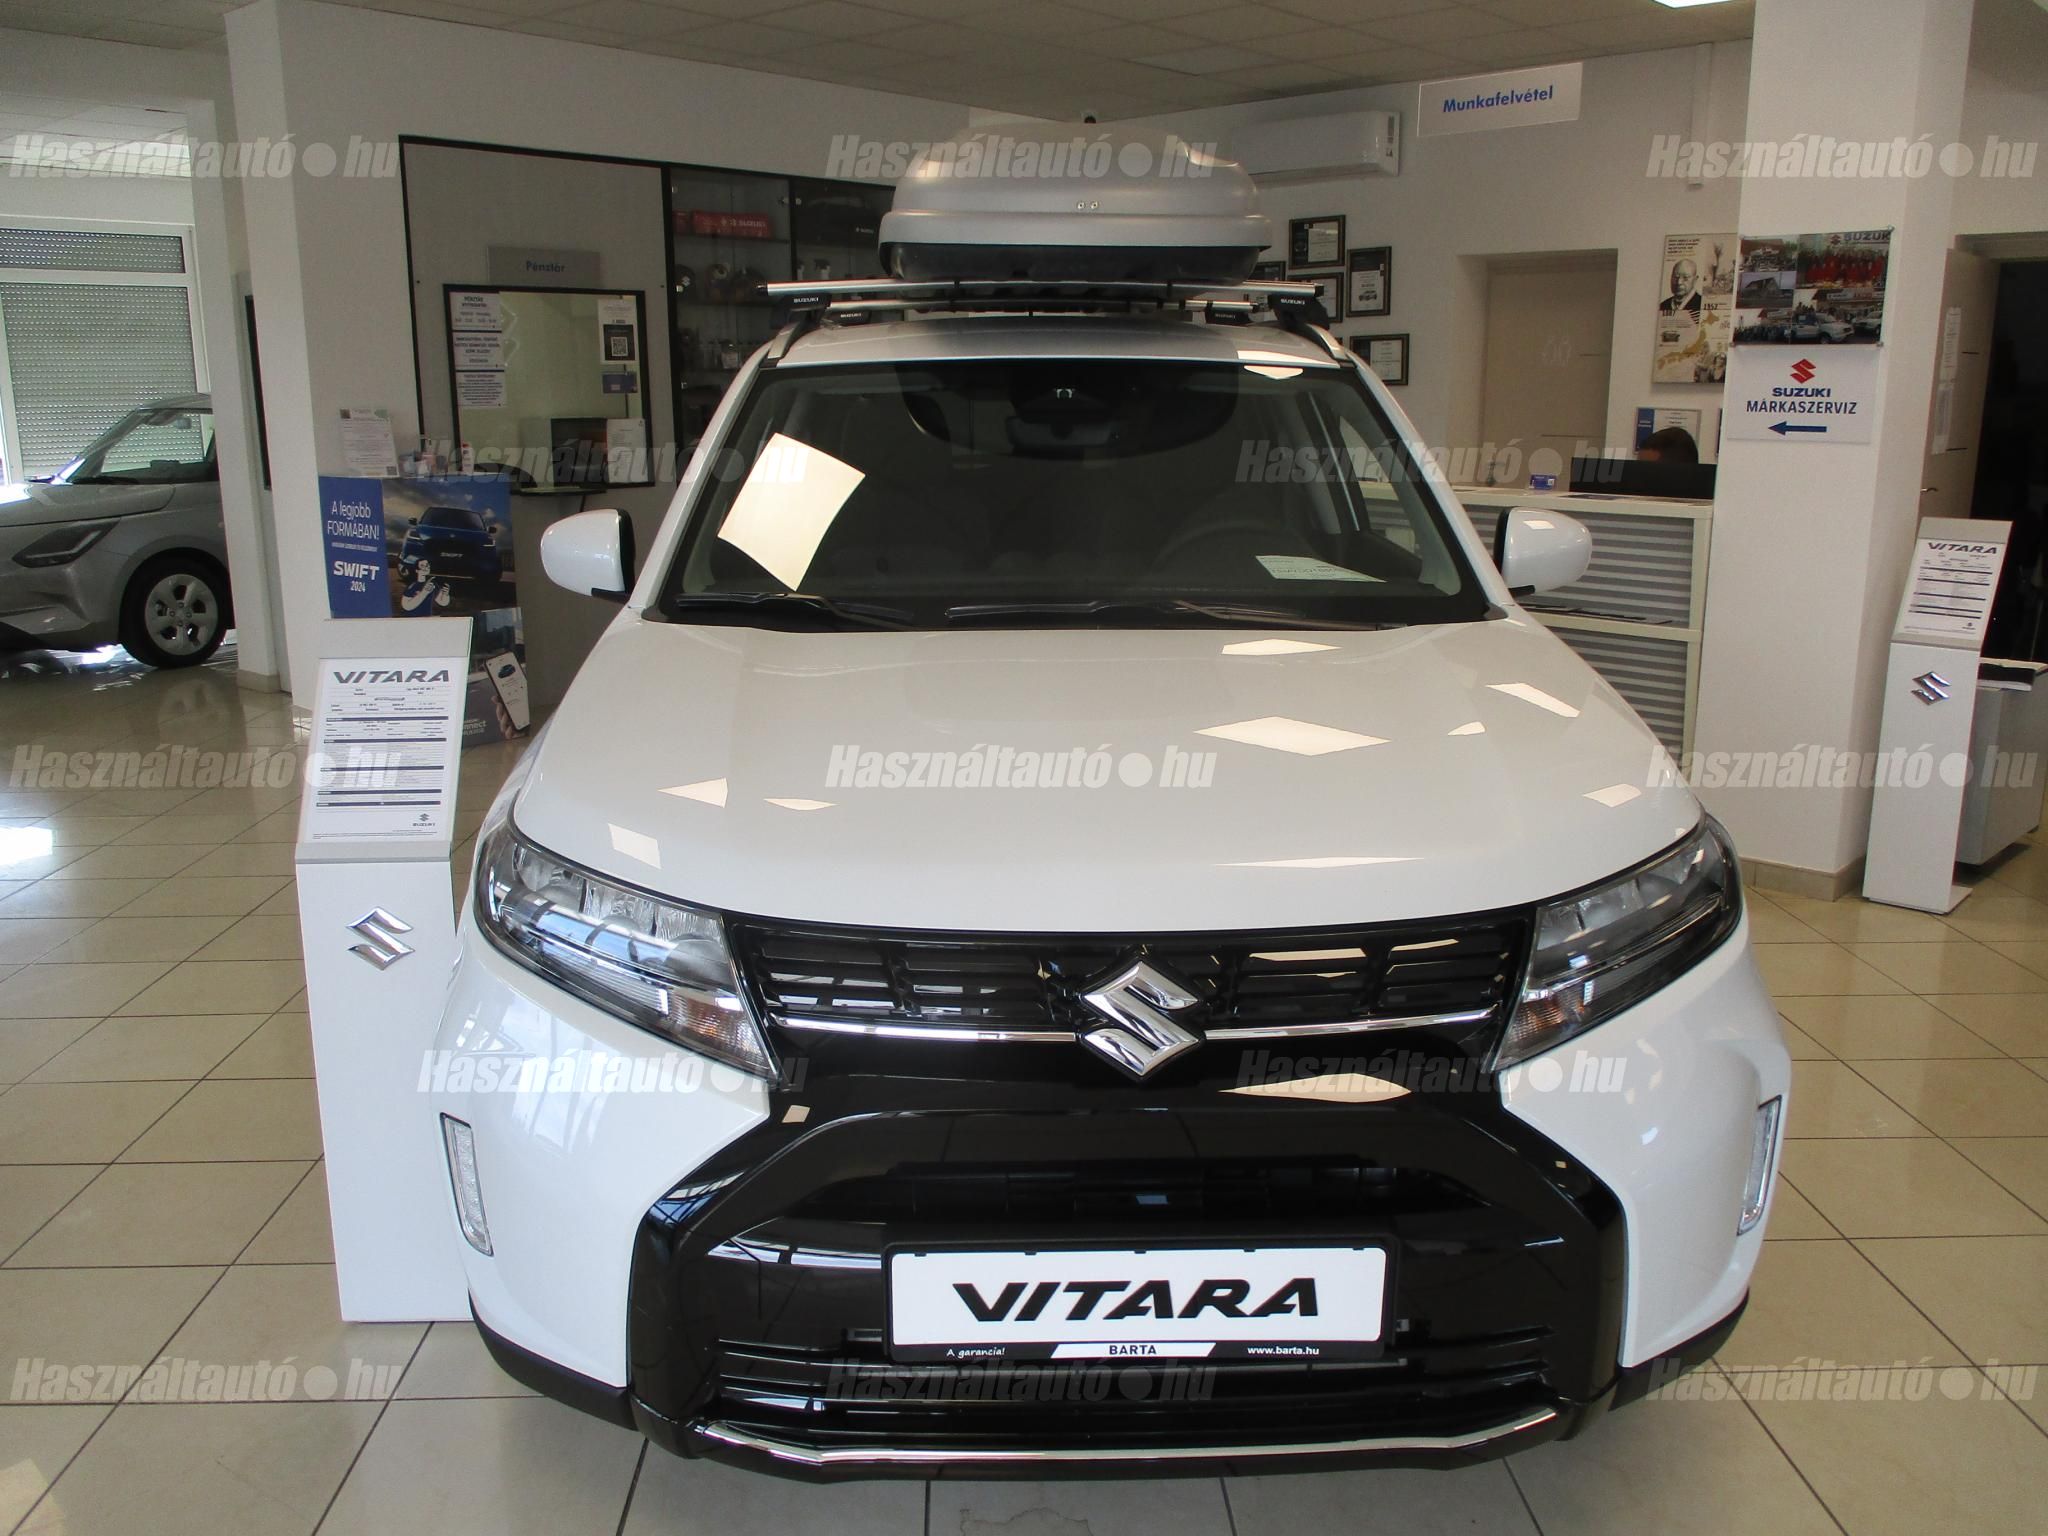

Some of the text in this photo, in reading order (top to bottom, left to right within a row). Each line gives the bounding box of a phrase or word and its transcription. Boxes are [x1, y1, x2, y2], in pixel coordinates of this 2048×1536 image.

[1443, 85, 1553, 112] Munkafelvétel
[1773, 387, 1831, 397] SUZUKI
[1746, 399, 1857, 416] MÁRKASZERVIZ
[331, 501, 372, 521] A legjobb
[1928, 542, 1998, 555] VITARA
[333, 560, 380, 581] SWIFT
[350, 581, 366, 593] 2024
[333, 670, 450, 684] VITARA
[953, 1277, 1319, 1322] VITARA
[946, 1347, 1006, 1358] A garancia!
[1109, 1344, 1158, 1356] BARTA
[1247, 1345, 1320, 1356] www.barta.hu
